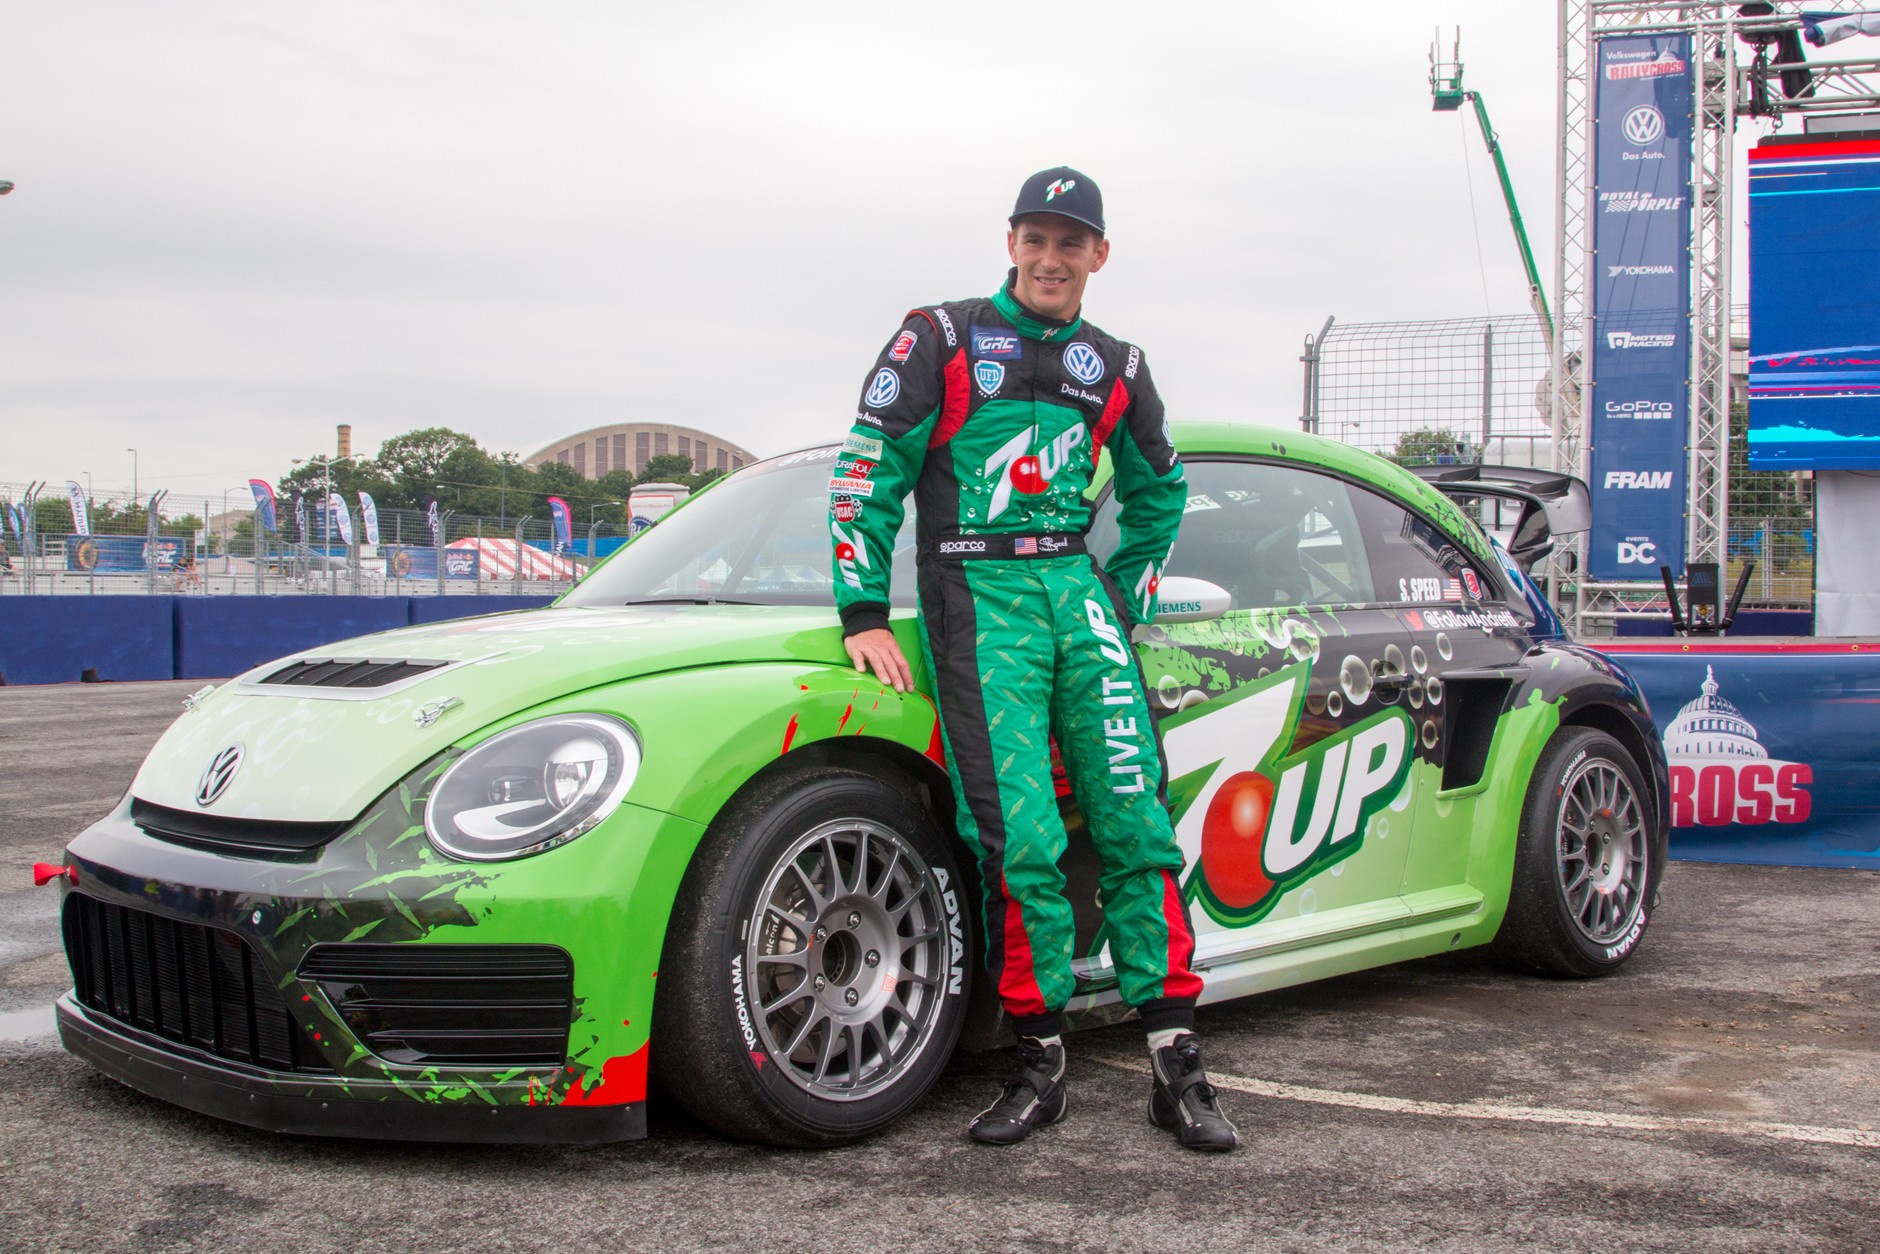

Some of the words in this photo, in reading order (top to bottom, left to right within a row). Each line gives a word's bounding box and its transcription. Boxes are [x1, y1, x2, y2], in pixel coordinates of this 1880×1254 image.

[1606, 51, 1657, 59] Volkswagen
[1608, 60, 1685, 80] RALLYCROSS
[1622, 152, 1640, 160] Das
[1641, 151, 1666, 159] Auto.
[1600, 191, 1639, 201] ROYAL
[1628, 197, 1682, 211] PURPLE
[1624, 265, 1675, 275] YOKOHAMA
[934, 309, 957, 346] sparco
[980, 336, 1018, 350] GRC
[1124, 346, 1140, 380] sparco
[979, 368, 999, 381] UFD
[1061, 383, 1079, 397] Das
[1080, 390, 1104, 405] Auto.
[1606, 401, 1673, 412] GoPro
[863, 411, 882, 426] Auto.
[830, 479, 872, 489] SYLVANIA
[1604, 471, 1673, 489] FRAM
[837, 506, 853, 518] USAC
[940, 541, 986, 553] sparco
[1617, 542, 1657, 564] DC
[1399, 577, 1411, 602] S.
[1410, 577, 1442, 601] SPEED
[1423, 610, 1519, 628] @FollowAndretti
[1085, 598, 1129, 667] UP
[1102, 677, 1134, 705] IT
[1104, 717, 1145, 794] LIVE
[765, 924, 779, 956] alcon
[931, 867, 964, 995] ADVAN
[1606, 908, 1646, 959] ADVAN
[732, 954, 757, 1051] YOKOHAMA
